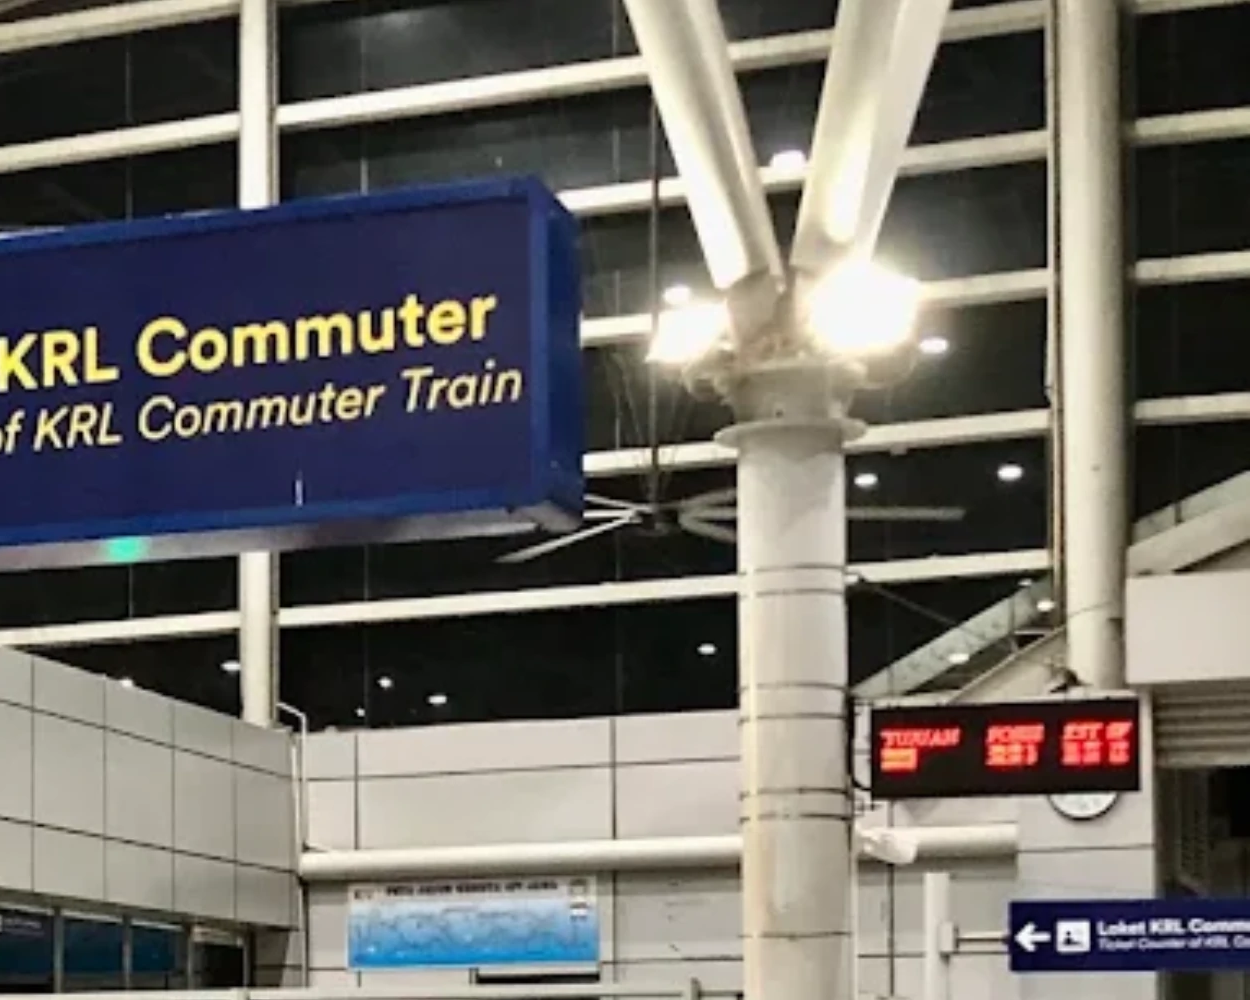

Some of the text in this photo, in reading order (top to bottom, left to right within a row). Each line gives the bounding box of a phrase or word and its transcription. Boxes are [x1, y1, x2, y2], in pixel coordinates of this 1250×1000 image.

[136, 293, 497, 377] Commuter
[33, 402, 123, 452] KRL
[137, 383, 386, 441] Commuter
[401, 359, 523, 413] Train
[1096, 918, 1250, 936] Loket KRL Comm
